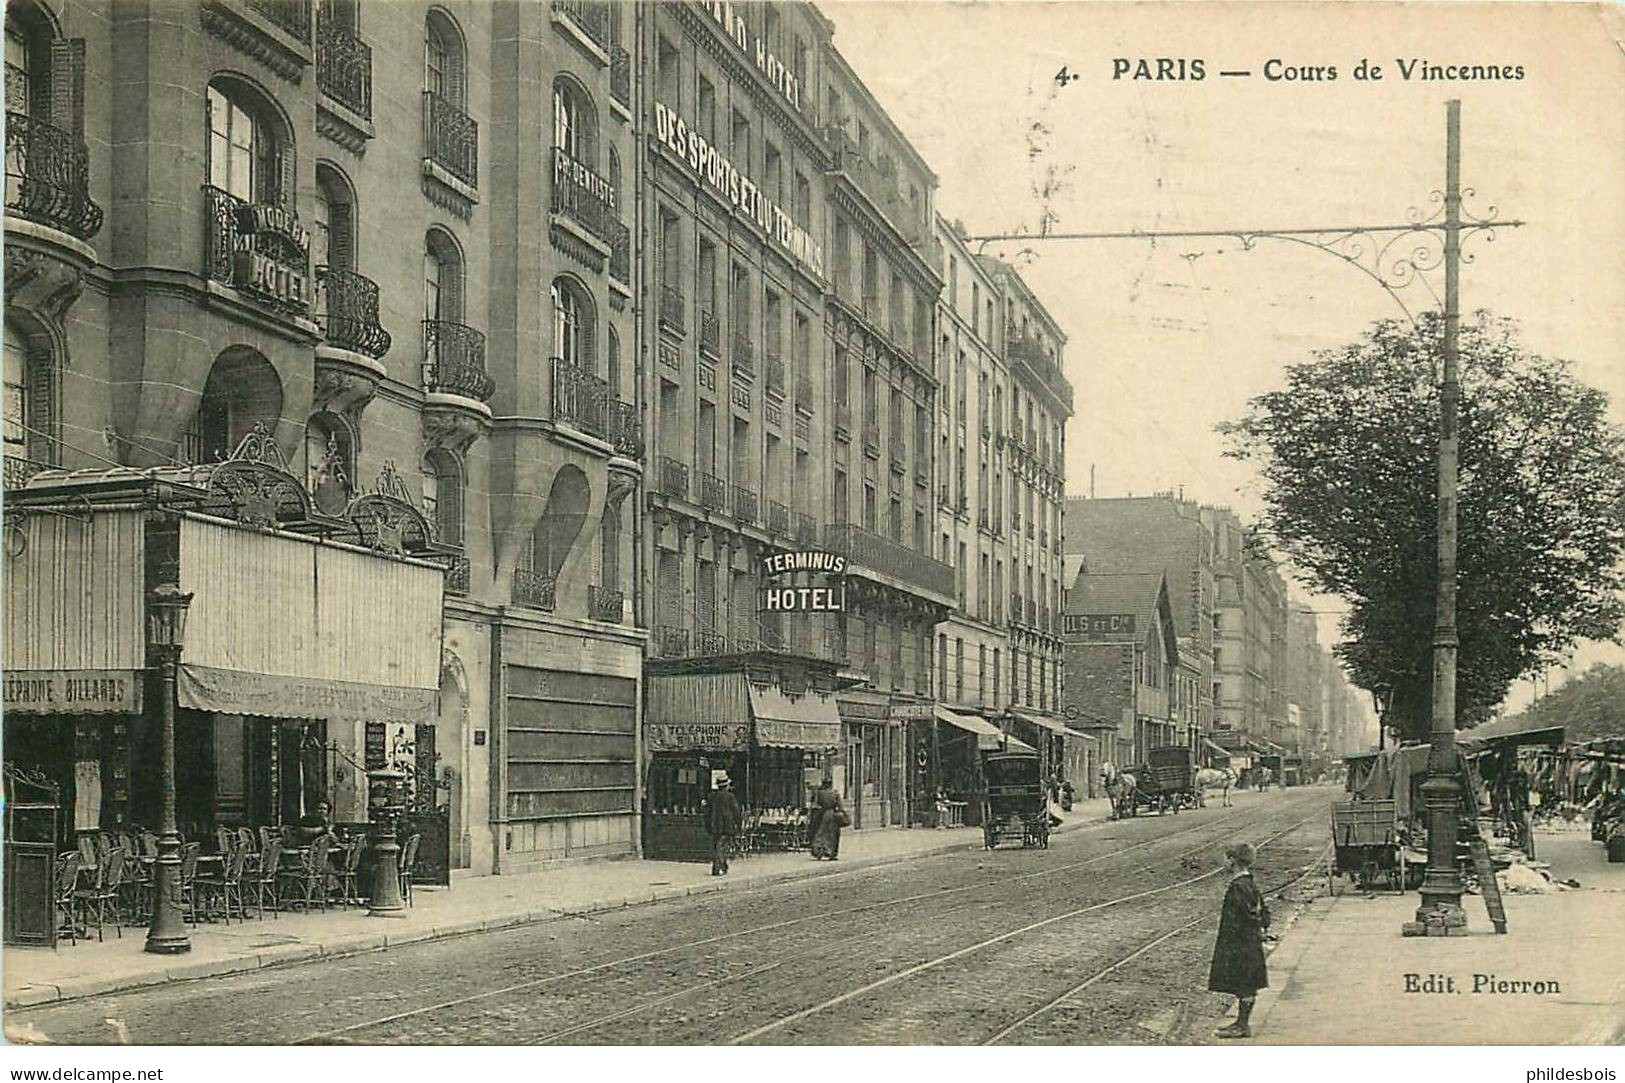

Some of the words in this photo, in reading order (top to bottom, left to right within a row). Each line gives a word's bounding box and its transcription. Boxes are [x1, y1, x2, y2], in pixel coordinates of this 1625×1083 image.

[756, 38, 801, 113] HOTEL
[573, 161, 615, 209] DENTISTE
[656, 101, 687, 160] DES
[688, 130, 739, 205] SPORTS
[740, 176, 756, 219] ET
[756, 190, 773, 234] DU
[774, 204, 823, 278] TERMINUS
[251, 252, 310, 305] HOTEL
[763, 552, 845, 574] TERMINUS
[767, 588, 840, 610] HOTEL
[66, 679, 125, 702] BILLARDS
